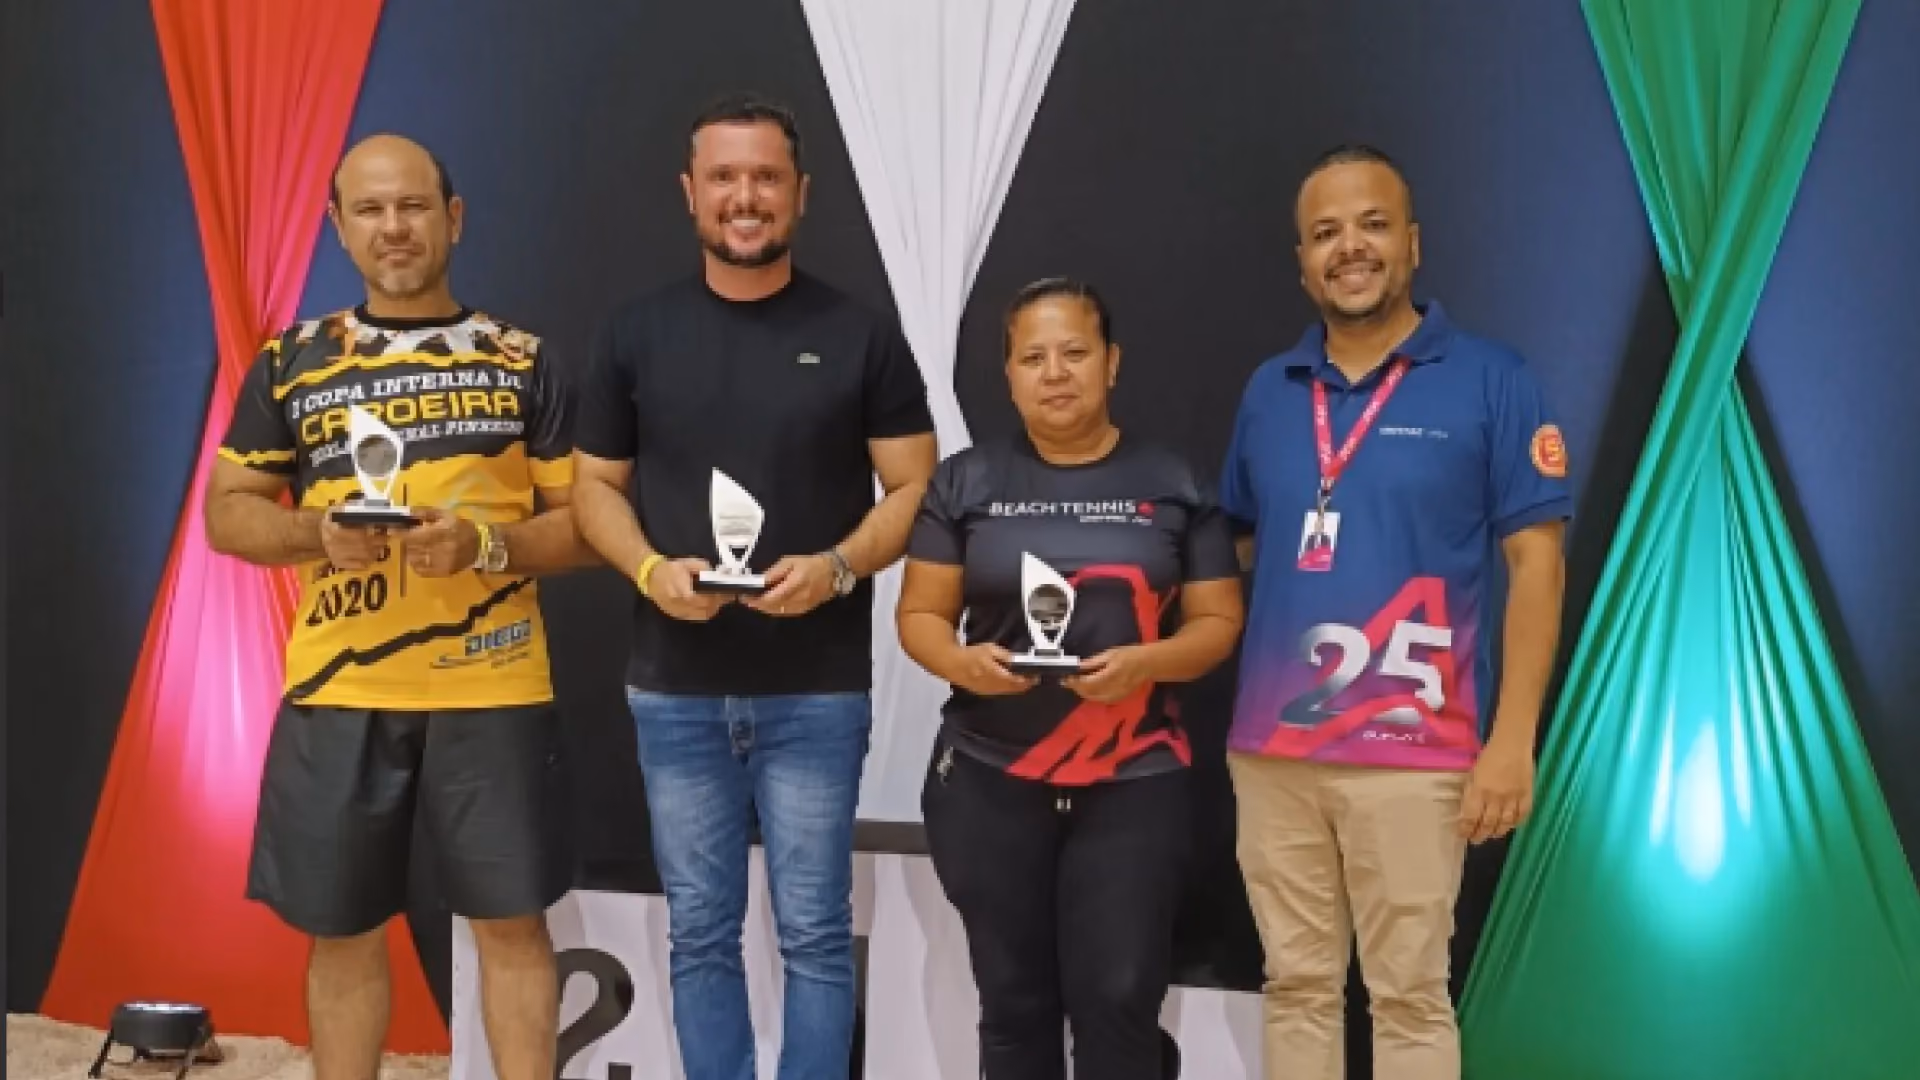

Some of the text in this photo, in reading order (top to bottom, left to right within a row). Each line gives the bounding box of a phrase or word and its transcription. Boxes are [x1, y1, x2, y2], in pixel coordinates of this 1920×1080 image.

[988, 500, 1137, 517] BEACH TENNIS
[306, 573, 388, 627] 2020
[1278, 619, 1454, 728] 25
